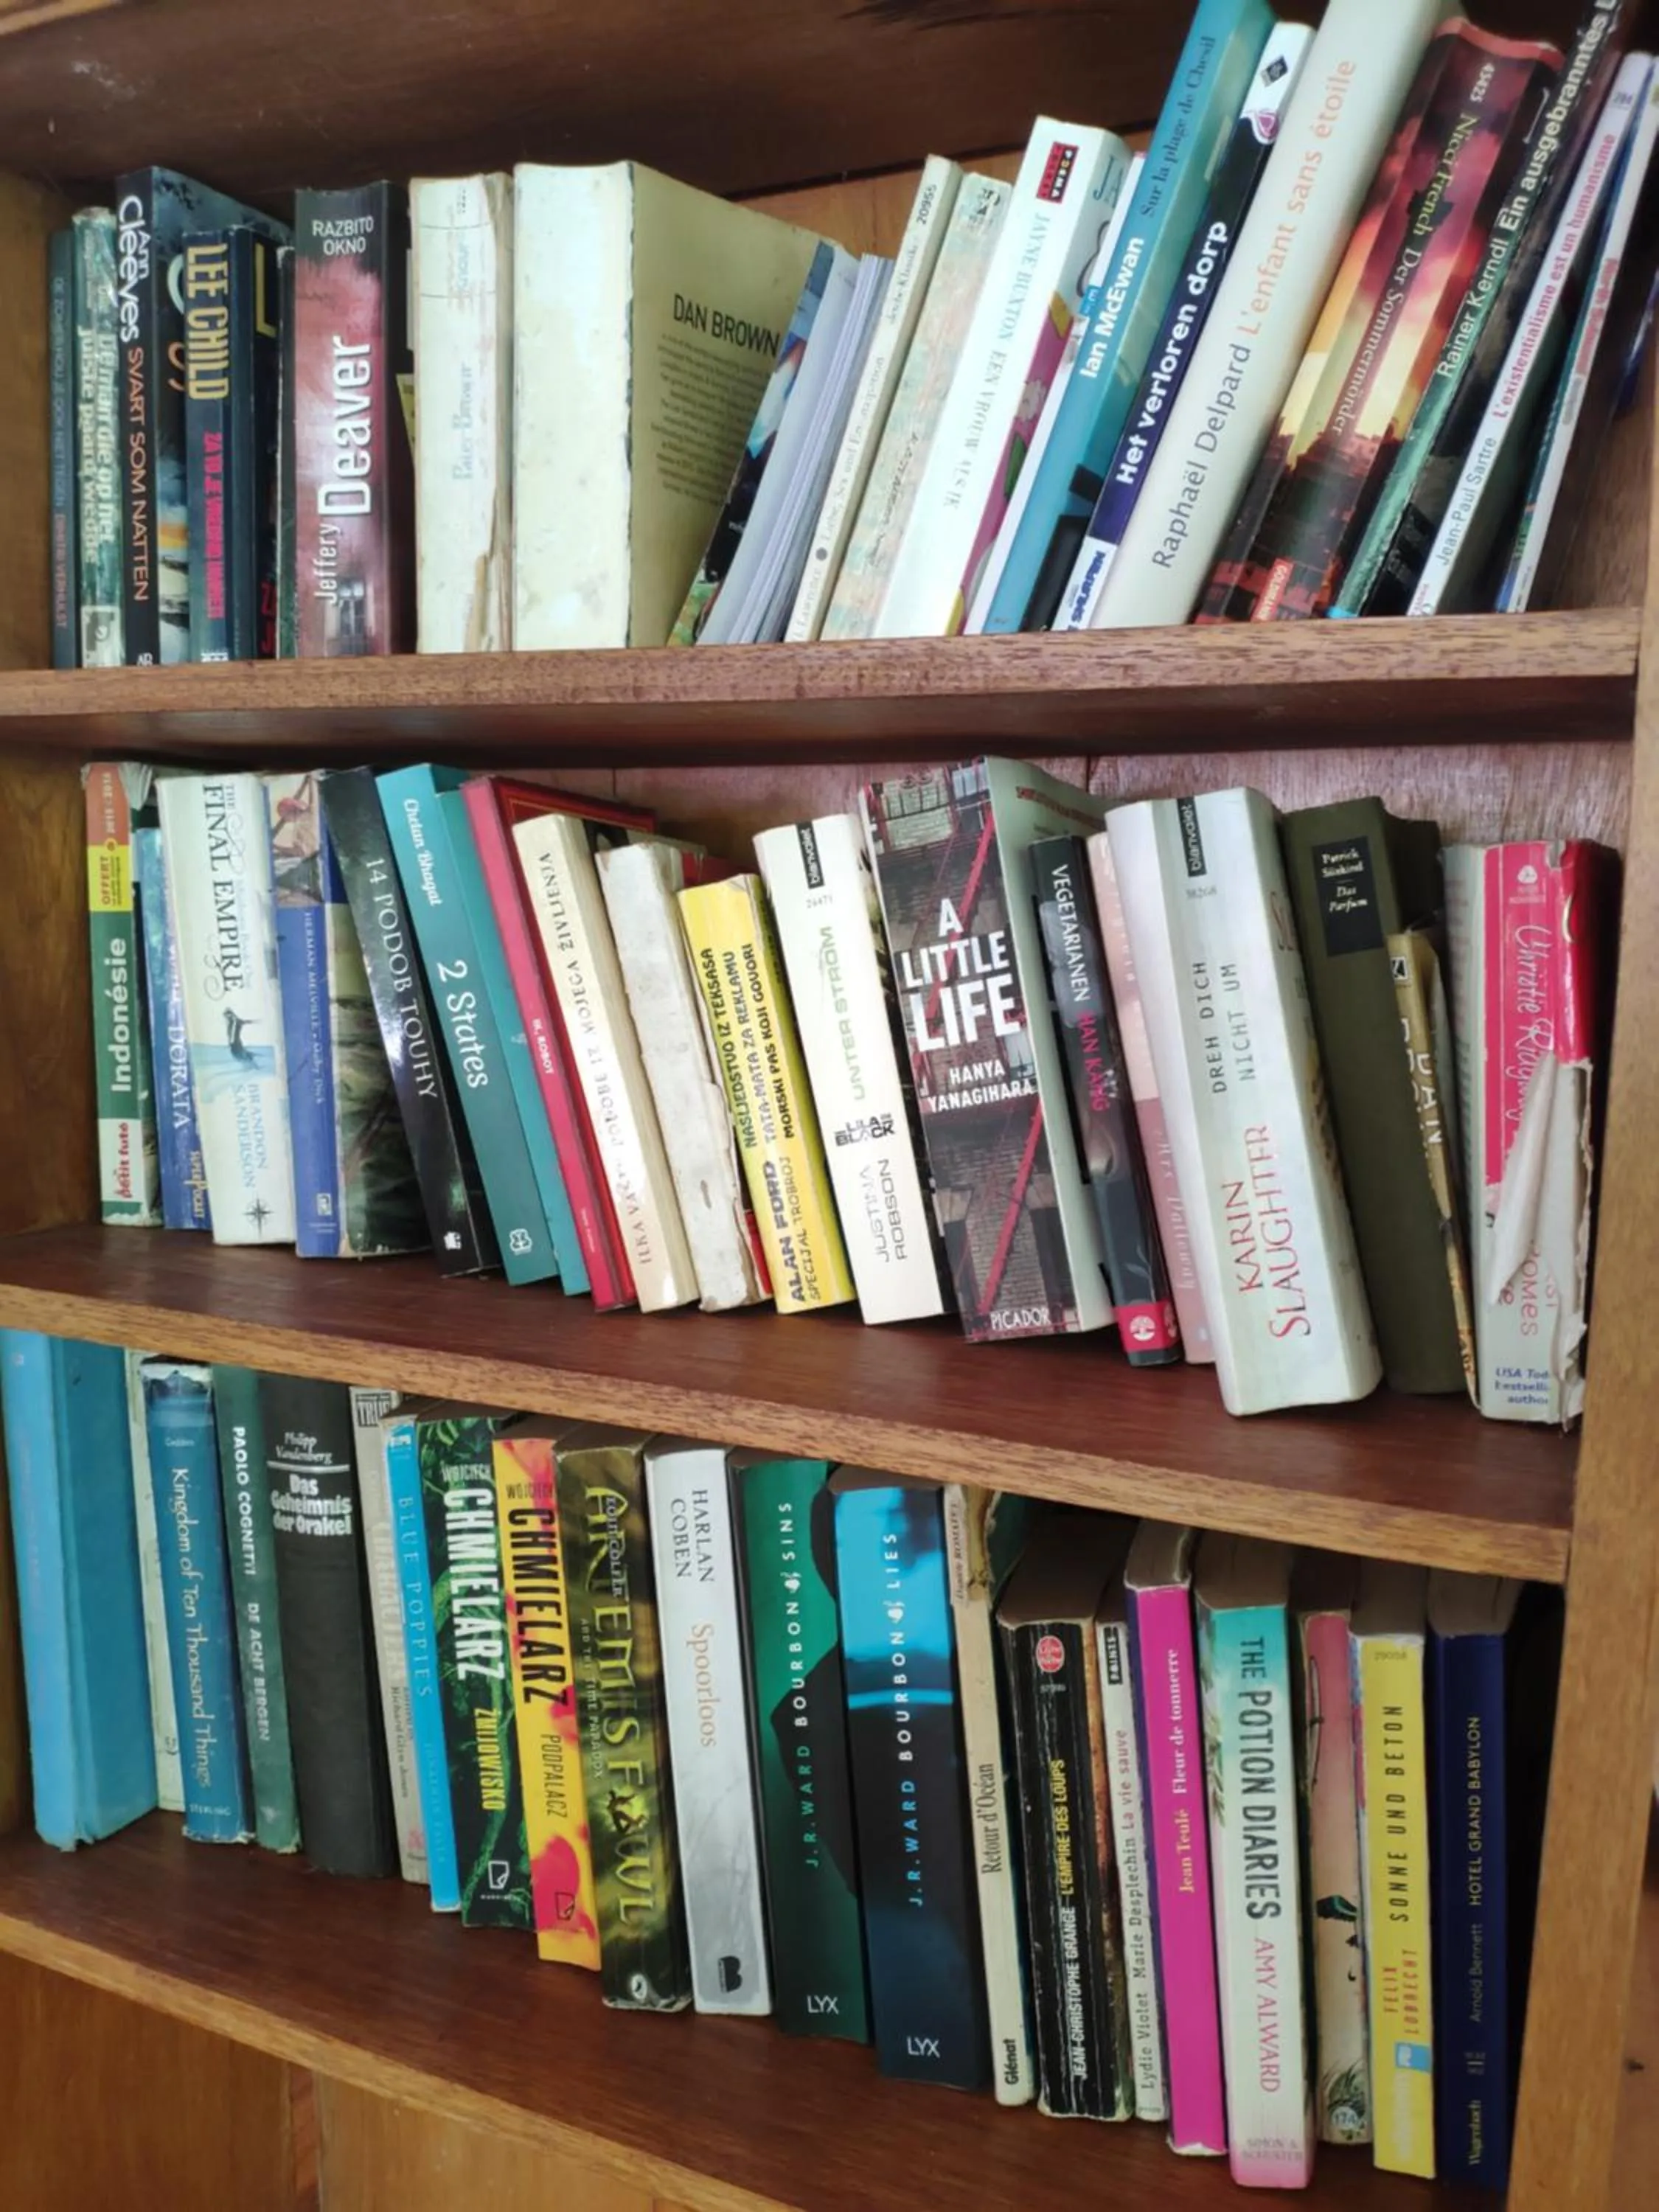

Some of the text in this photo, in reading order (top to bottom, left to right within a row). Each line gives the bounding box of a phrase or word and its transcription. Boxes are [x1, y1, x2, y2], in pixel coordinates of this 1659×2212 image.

[1141, 36, 1216, 216] Sur la de Chesil
[1413, 113, 1481, 236] Nicci French
[1499, 194, 1528, 232] Ein
[1520, 14, 1608, 192] ausgebranntes
[312, 217, 374, 237] RAZBITO
[1236, 60, 1357, 336] L'enfant sans étoile
[1568, 133, 1616, 230] humanisme
[117, 195, 144, 343] Cleeves
[135, 229, 150, 276] Ann
[324, 237, 366, 255] OKNO
[1551, 256, 1569, 282] est
[1561, 231, 1578, 254] un
[185, 243, 229, 400] LEE CHILD
[672, 293, 780, 358] DAN BROWN
[1081, 341, 1107, 378] Ian
[1095, 237, 1144, 338] McEwan
[1115, 220, 1228, 486] Het verloren dorp
[1332, 248, 1422, 437] Der Sommermörder
[1436, 237, 1509, 378] Rainer Kerndl
[1492, 285, 1556, 420] L'existentialisme
[982, 349, 1007, 386] EEN
[125, 346, 148, 601] SVART SOM NATTEN
[314, 335, 370, 606] Jeffery Deaver
[1152, 343, 1252, 569] Raphaël Delpard
[1436, 437, 1497, 567] Jean-Paul Sartre
[203, 783, 245, 992] FINAL EMPIRE
[403, 798, 444, 908] Chetan Bhagat
[1180, 803, 1203, 872] blanvalet
[1335, 885, 1357, 898] Das
[305, 911, 316, 967] HERMAN
[901, 930, 1010, 989] LITTLE
[939, 897, 964, 937] A
[1328, 897, 1368, 914] Parfum
[104, 938, 132, 1092] Indonésie
[366, 858, 439, 1099] 14 PODOB TOUHY
[437, 959, 489, 1089] 2 States
[700, 947, 731, 1037] IZ TEKSASA
[723, 951, 758, 1055] ZA REKLAMU
[819, 926, 866, 1101] UNTER STROM
[910, 972, 1022, 1053] LIFE
[1051, 863, 1110, 1113] VEGETARIANEN HAN KANG
[1220, 963, 1257, 1082] NICHT UM
[1514, 924, 1553, 1015] Christie
[535, 1036, 555, 1075] ROBOT
[536, 851, 653, 1265] ILKA ŽIVLJENJA
[741, 943, 795, 1140] MORSKI PAS KOJI GOVORI
[948, 1059, 1006, 1085] HANYA
[1192, 961, 1228, 1093] DREH DICH
[234, 1085, 256, 1189] SANDERSON
[248, 1084, 267, 1170] BRANDON
[926, 1079, 1034, 1114] YANAGIHARA
[762, 1161, 807, 1302] ALAN FORD
[877, 1158, 908, 1261] ROBSON
[1221, 1180, 1265, 1293] KARIN
[1243, 1124, 1312, 1339] SLAUGHTER
[990, 1307, 1053, 1331] PICADOR
[1495, 1366, 1523, 1379] USA
[270, 1489, 354, 1516] Geheimnis
[289, 1473, 319, 1497] Das
[295, 1514, 352, 1537] Orakel
[398, 1497, 420, 1564] BLUE
[670, 1498, 692, 1579] COBEN
[692, 1489, 716, 1582] HARLAN
[170, 1467, 218, 1788] Kingdom of Ten Thousand Things
[232, 1425, 272, 1742] PAOLO COGNETTI DE ACHT BERGEN
[443, 1488, 506, 1681] CHMIELARZ
[508, 1508, 569, 1707] CHMIELARZ
[778, 1502, 809, 1728] BOURBON SINS
[406, 1584, 434, 1699] POPPIES
[686, 1623, 721, 1749] Spoorloos
[883, 1533, 914, 1762] BOURBON LIES
[540, 1733, 568, 1818] PODPALACZ
[1166, 1649, 1188, 1795] Fleur de tonnerre
[1237, 1636, 1282, 1920] THE POTION DIARIES
[974, 1762, 1003, 1875] Retour d'Océan
[1049, 1759, 1076, 1896] L'EMPIRE DES LOUPS
[1115, 1729, 1134, 1830] La vie sauve
[1382, 1705, 1410, 1924] SONNE UND BETON
[1467, 1716, 1483, 1907] HOTEL GRAND BABYLON
[1174, 1806, 1196, 1894] Jean Teulé
[1121, 1836, 1146, 1978] Marie Desplechin
[807, 1994, 840, 2015] LYX
[1135, 1992, 1151, 2039] Violet
[1253, 1936, 1281, 2093] AMY ALWARD
[1469, 1923, 1484, 2023] Arnold Bennett
[906, 2036, 941, 2059] LYX
[1004, 2038, 1019, 2086] Glénat
[1138, 2045, 1156, 2090] Lydie
